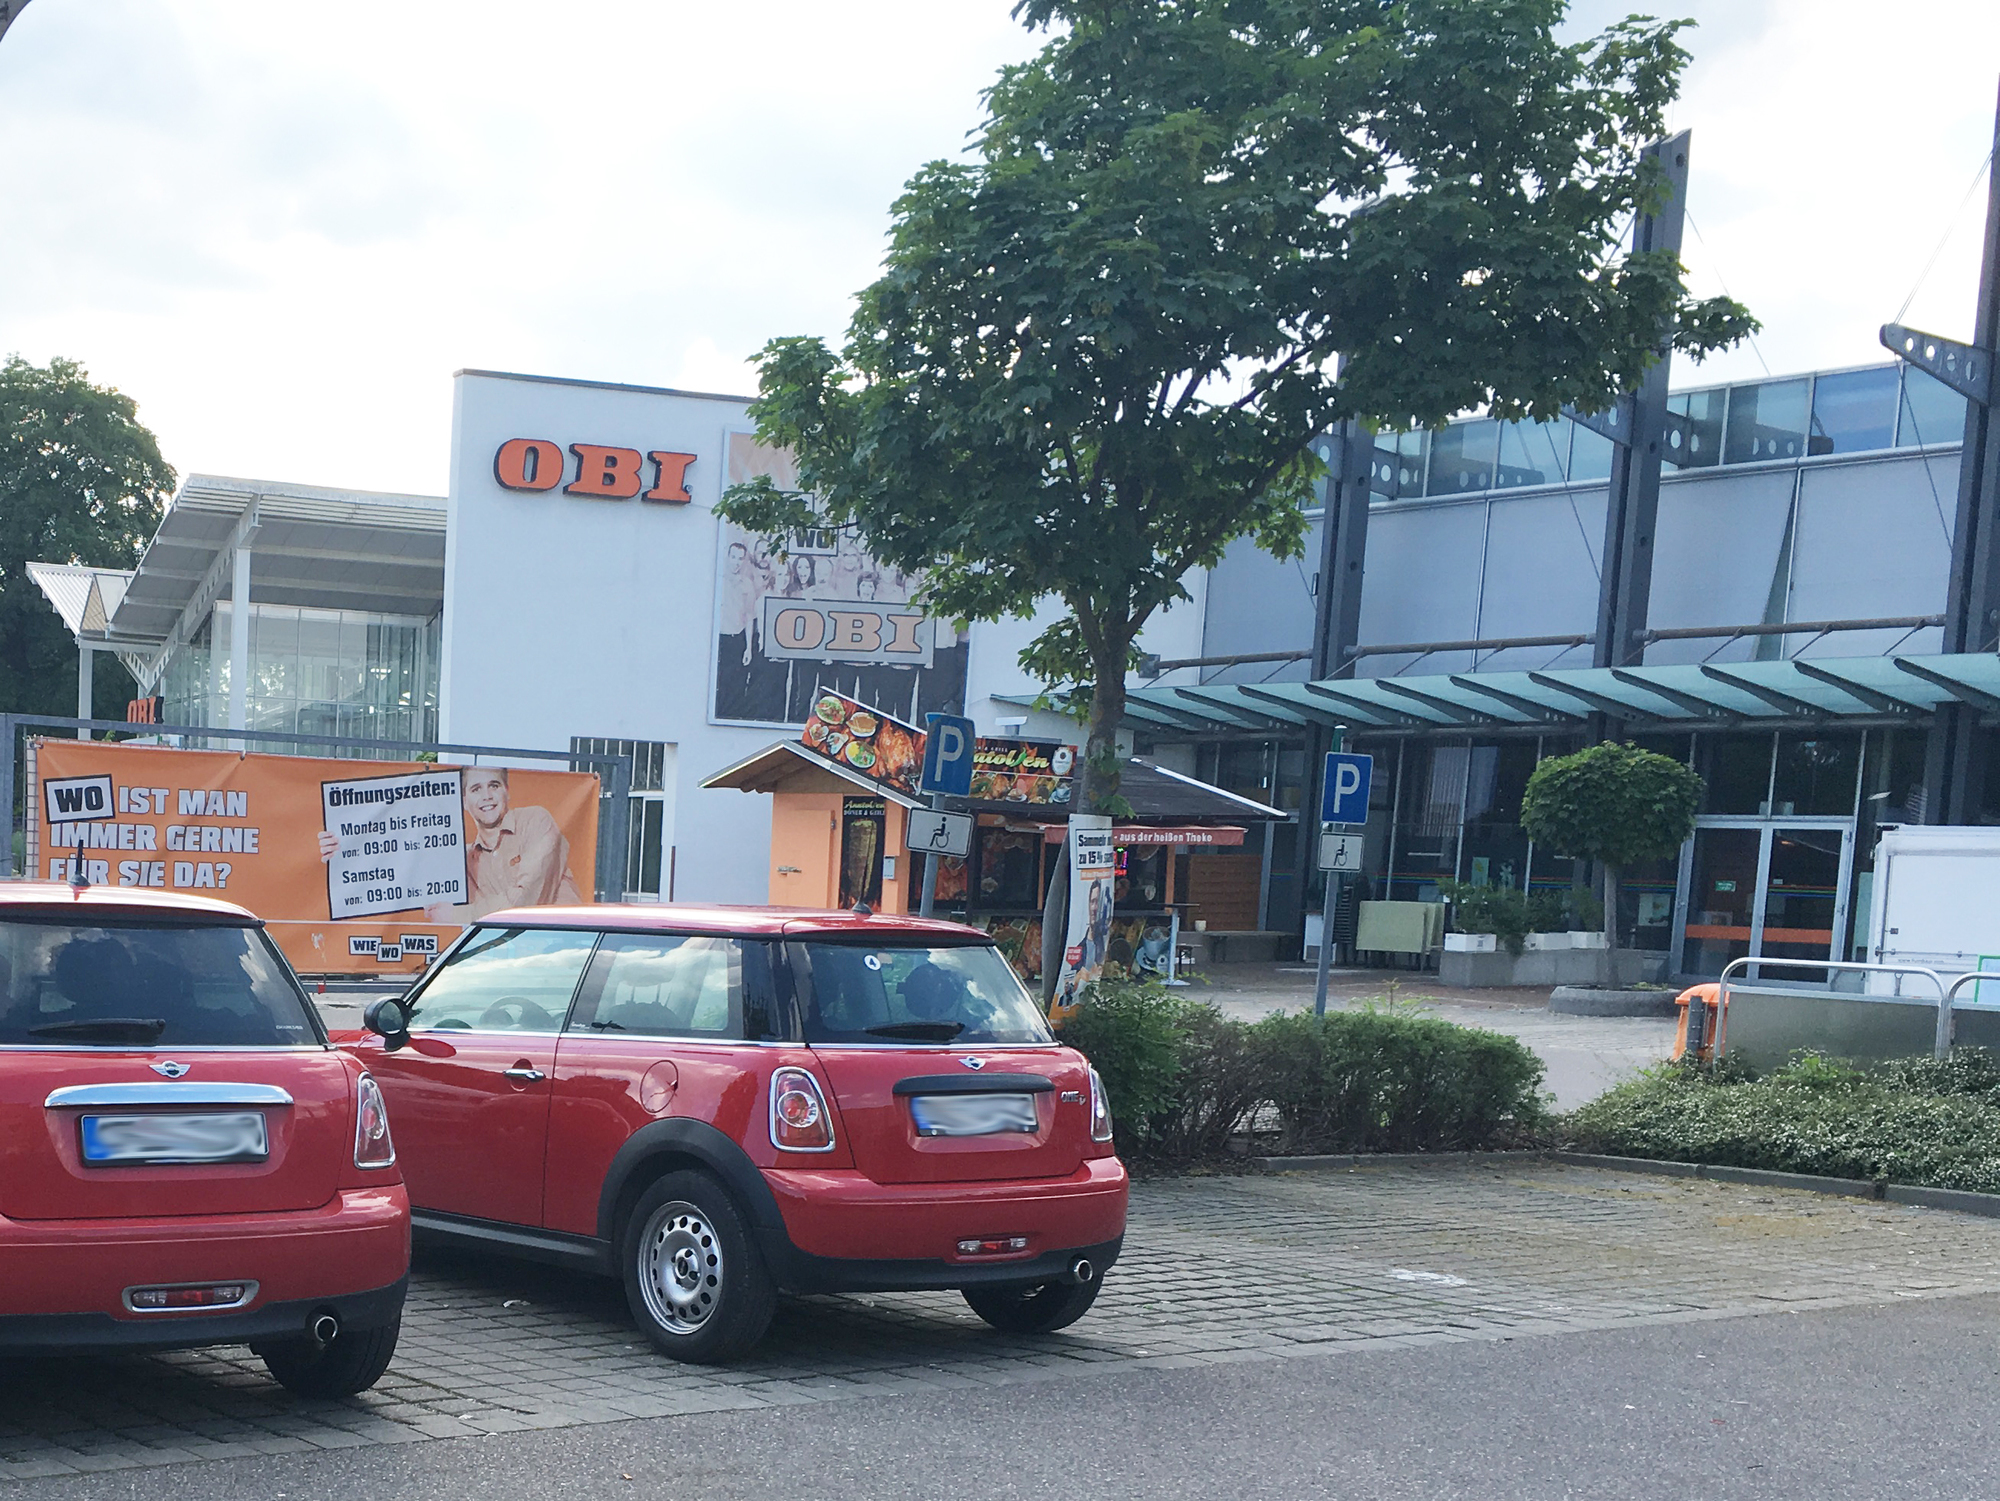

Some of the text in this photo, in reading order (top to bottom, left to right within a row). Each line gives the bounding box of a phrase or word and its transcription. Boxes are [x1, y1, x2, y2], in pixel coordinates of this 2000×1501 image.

[493, 438, 698, 503] OBI
[774, 608, 925, 654] OBI
[935, 725, 964, 782] P
[54, 786, 248, 817] WO IST MAN
[329, 781, 456, 807] Öffnungszeiten:
[1333, 763, 1360, 814] P
[50, 822, 260, 854] IMMER GERNE
[340, 813, 451, 837] Montag bis Freitag
[1120, 834, 1136, 842] aus
[1137, 832, 1152, 842] der
[342, 833, 457, 859] von: 09:00 bis: 20:00
[50, 853, 232, 889] FÜR SIE DA?
[342, 867, 395, 884] Samstag
[344, 879, 459, 906] von: 09:00 bis: 20:00
[353, 940, 377, 951] WIE
[381, 947, 399, 958] WO
[404, 938, 435, 951] WAS
